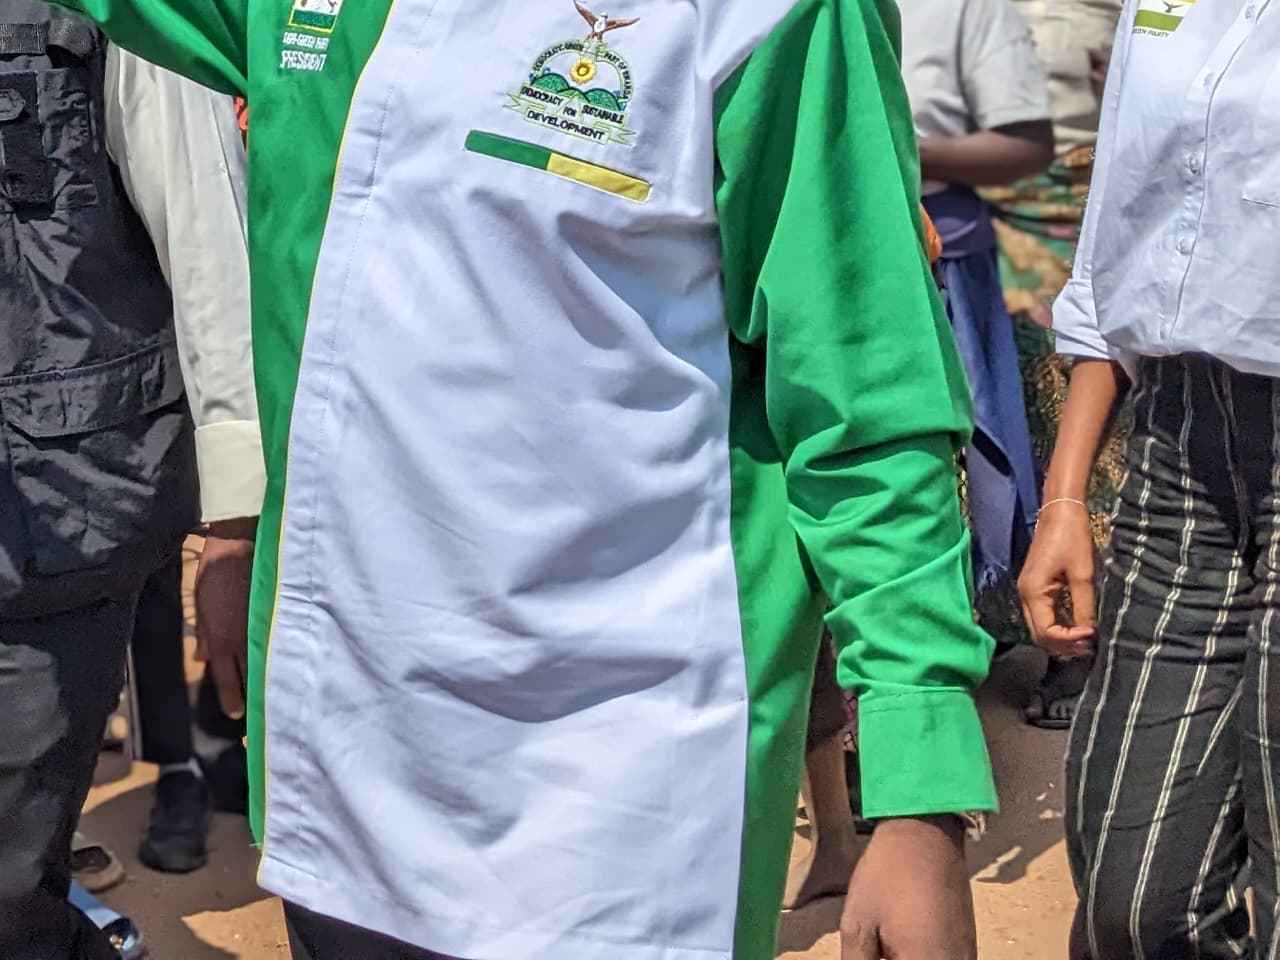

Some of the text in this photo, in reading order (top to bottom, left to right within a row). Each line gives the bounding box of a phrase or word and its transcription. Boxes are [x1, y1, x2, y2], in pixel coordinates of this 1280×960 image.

[520, 86, 564, 106] DEMOCRACY
[563, 106, 577, 118] FOR
[527, 110, 606, 140] DEVELOPMENT
